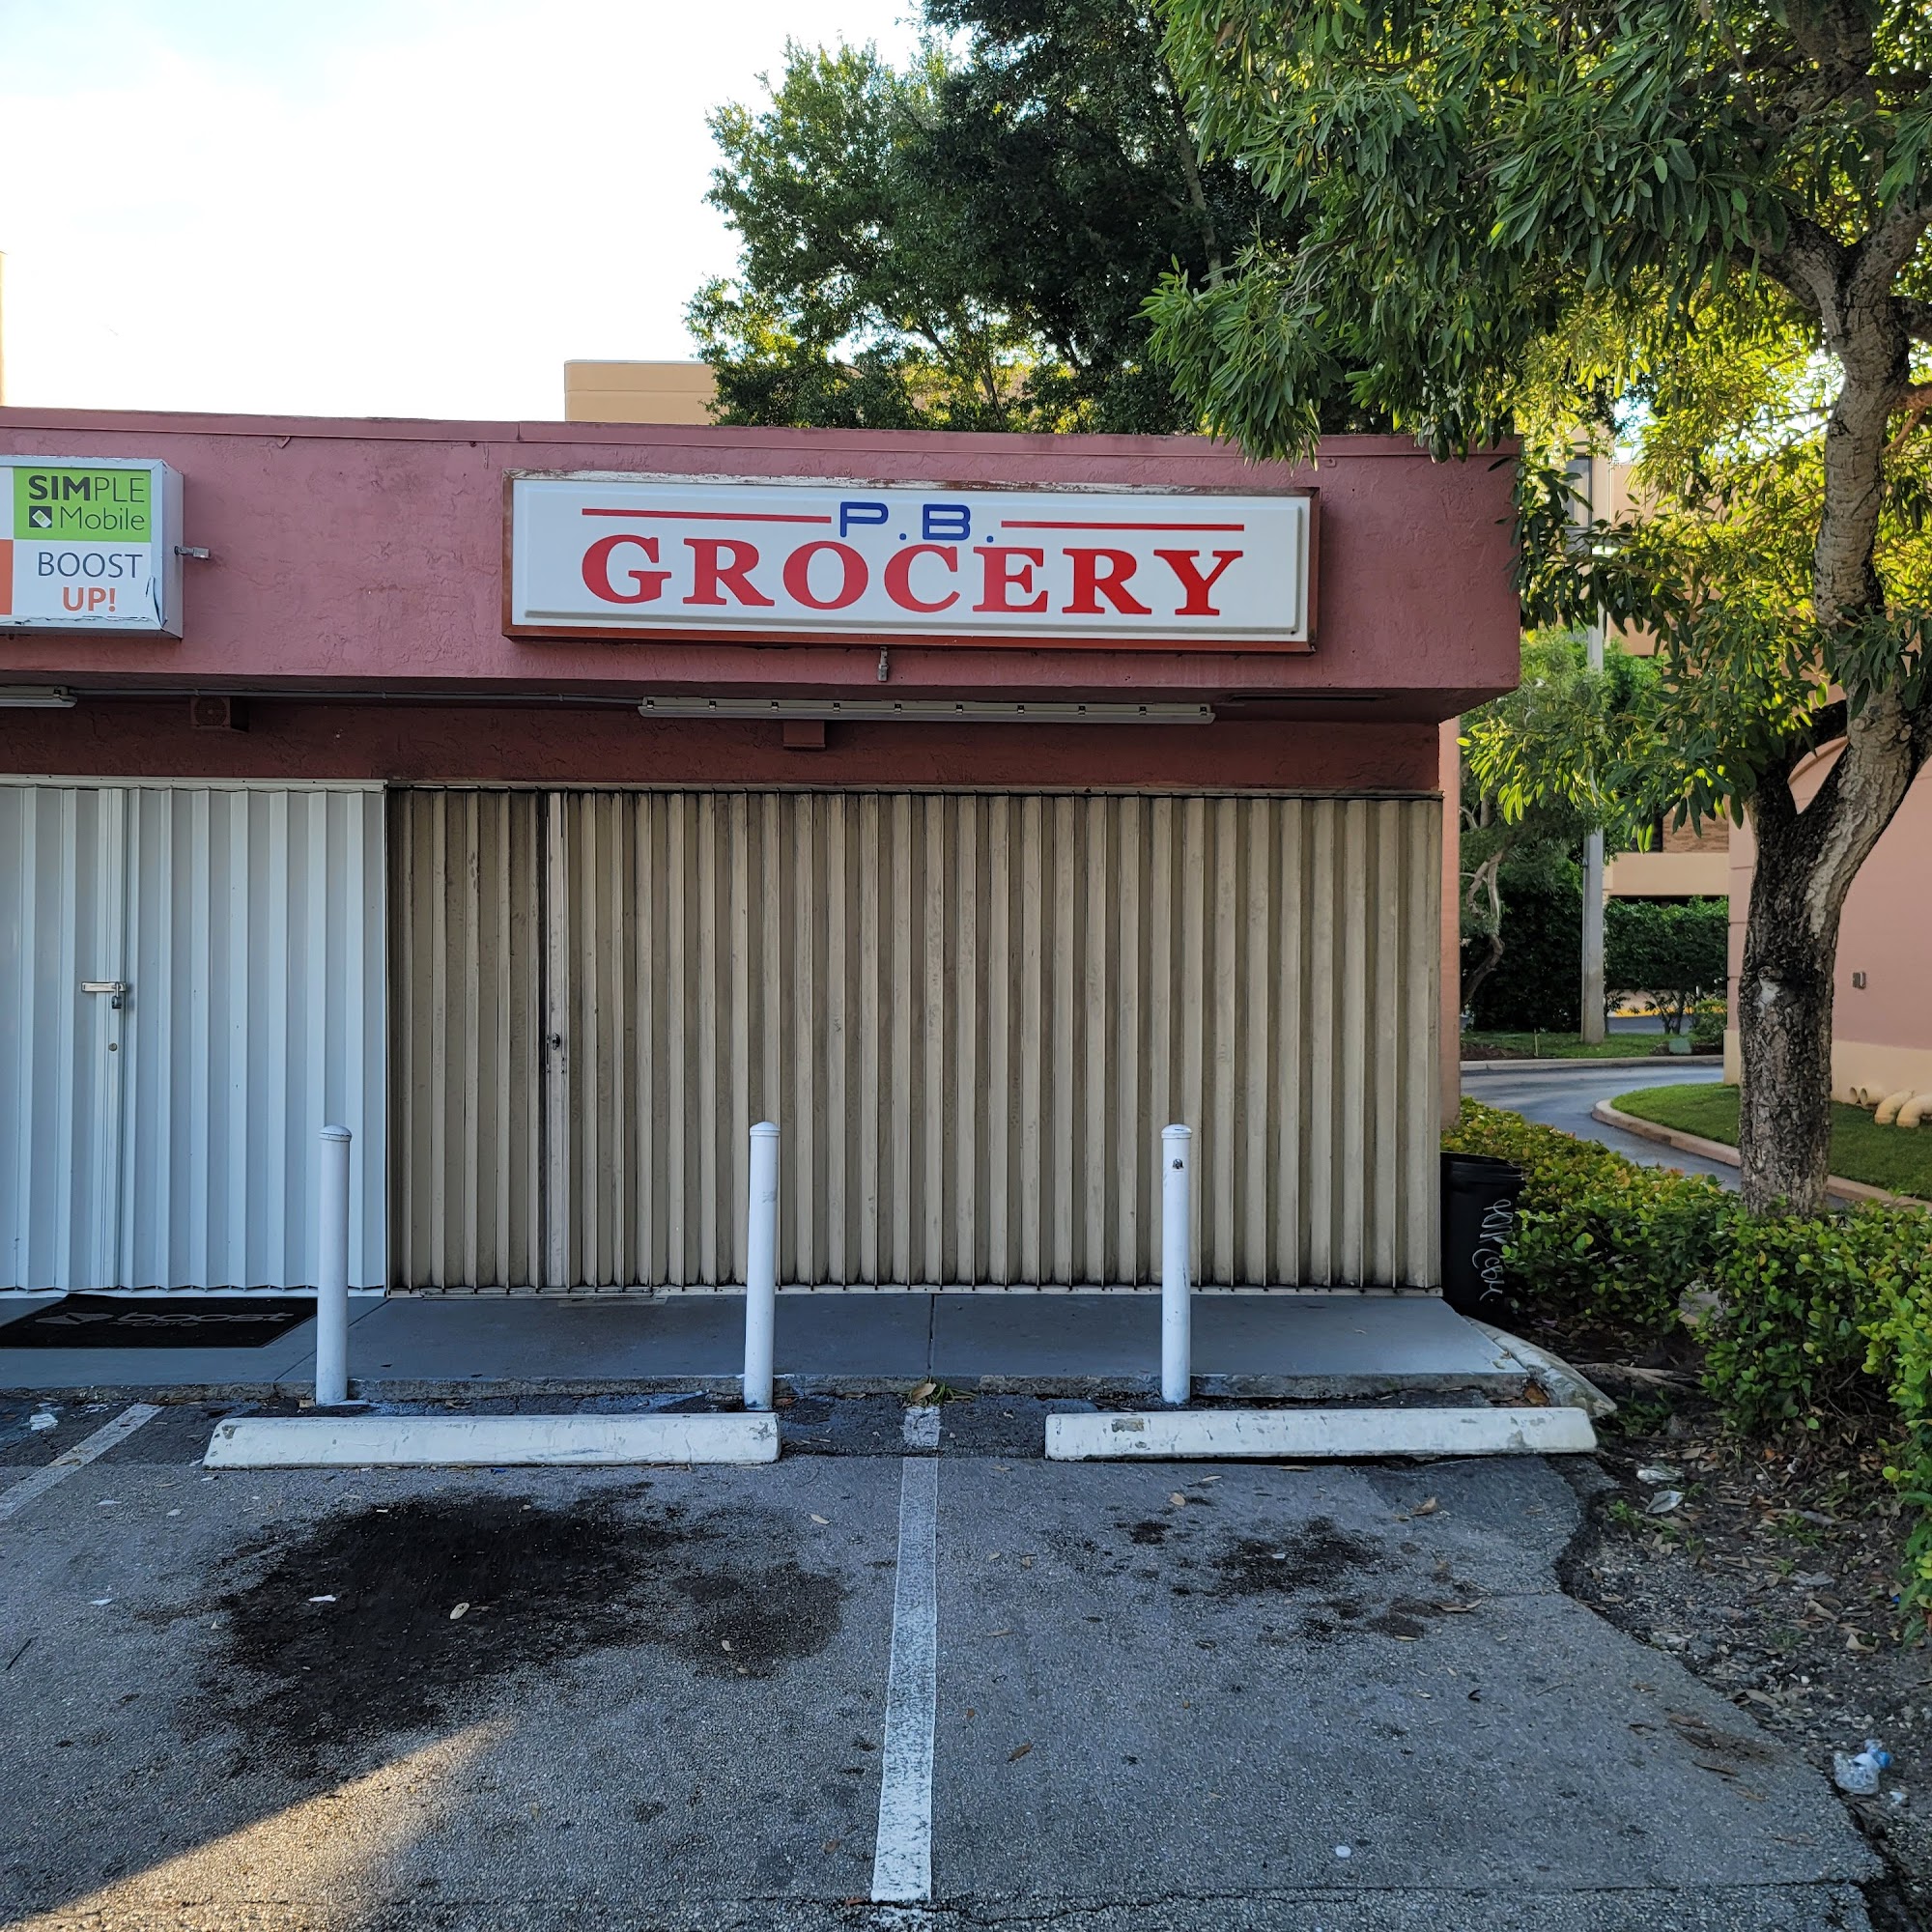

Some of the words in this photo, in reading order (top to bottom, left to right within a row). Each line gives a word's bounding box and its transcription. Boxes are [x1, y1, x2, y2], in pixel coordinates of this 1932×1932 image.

[28, 474, 145, 503] SIMPLE
[60, 506, 145, 530] Mobile
[838, 501, 996, 544] P.B.
[38, 552, 143, 578] BOOST
[581, 533, 1245, 617] GROCERY
[63, 586, 116, 612] UP!
[117, 1312, 295, 1322] boost
